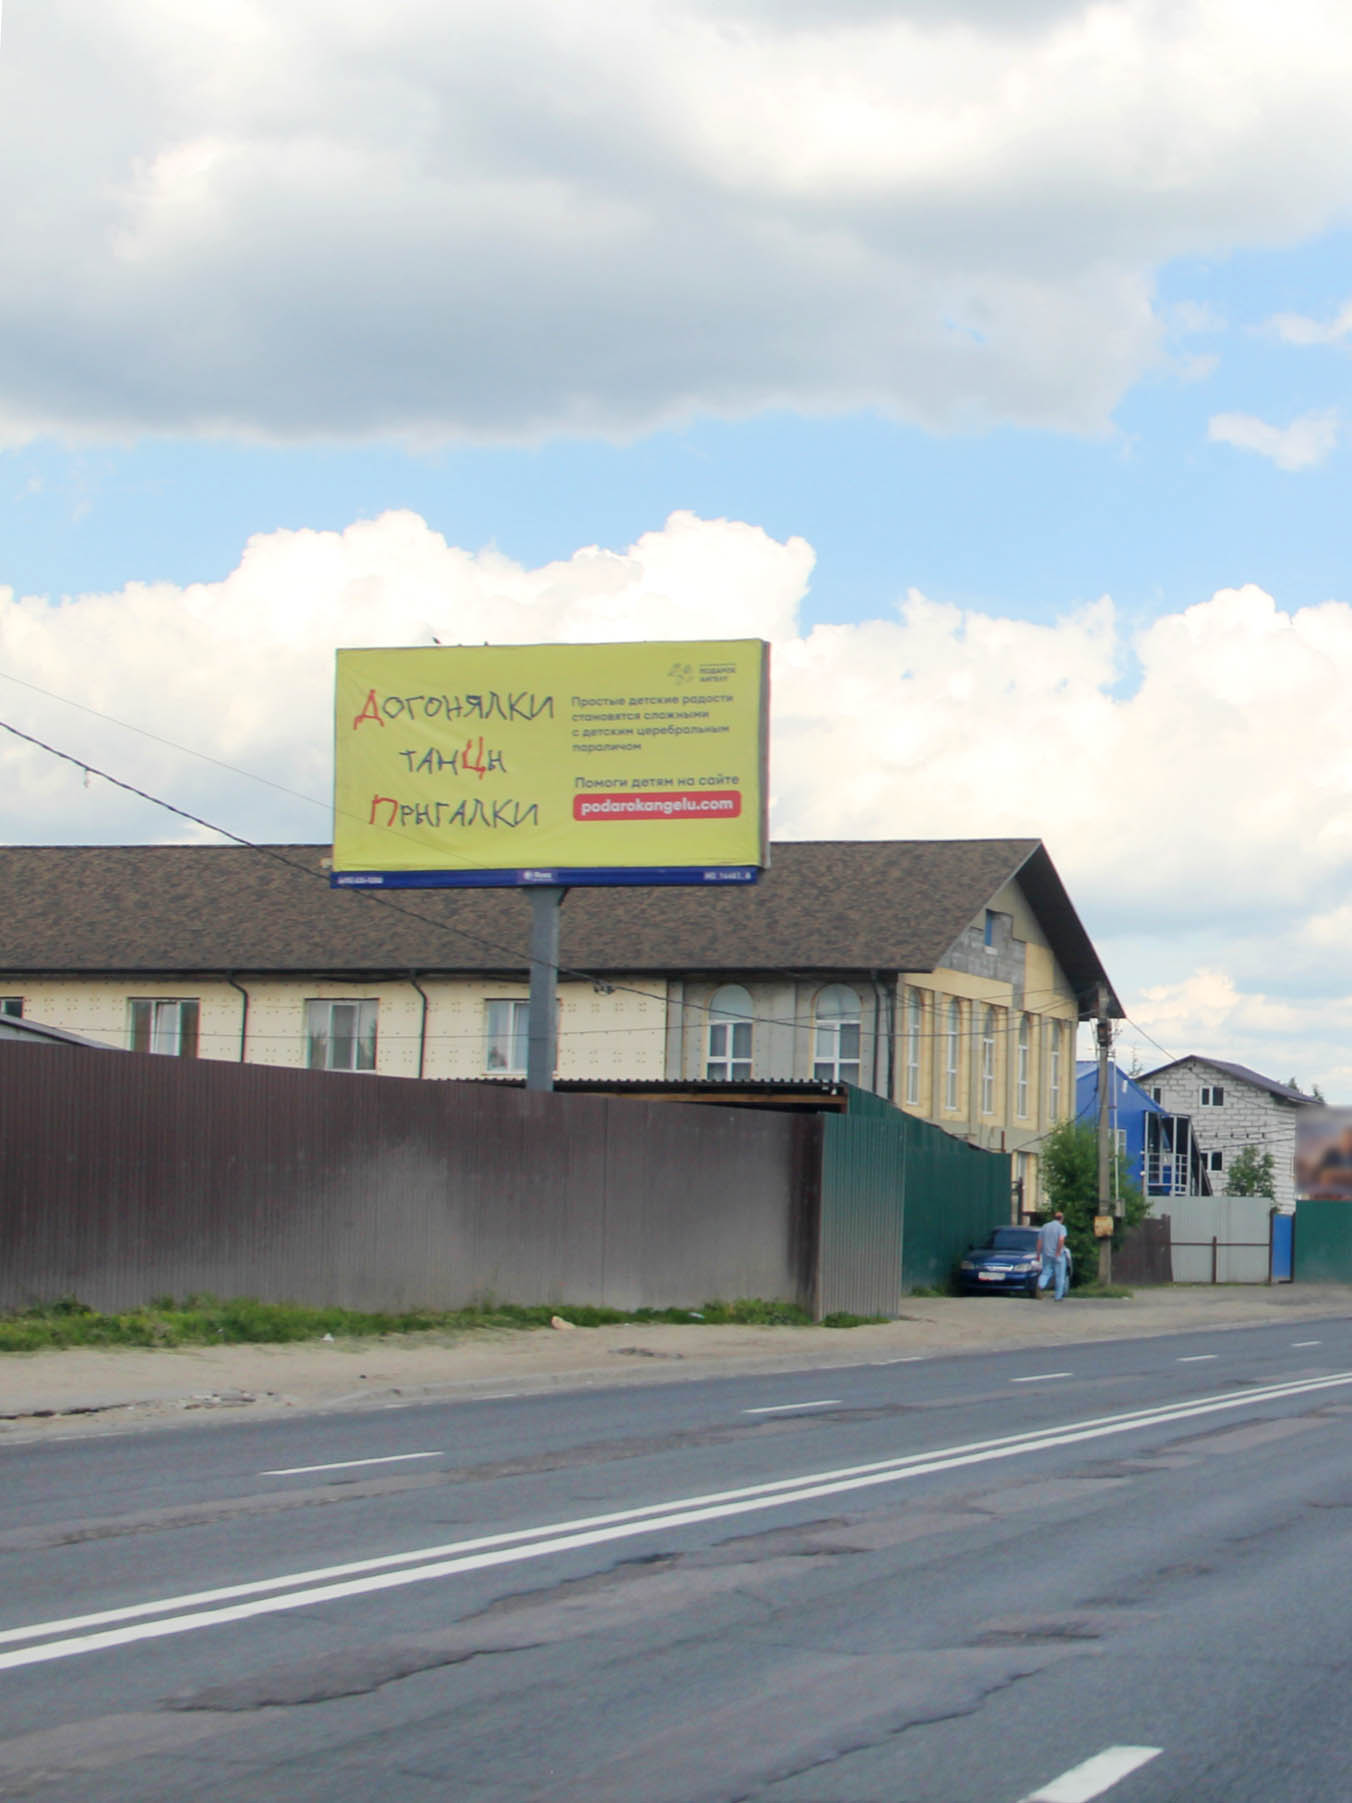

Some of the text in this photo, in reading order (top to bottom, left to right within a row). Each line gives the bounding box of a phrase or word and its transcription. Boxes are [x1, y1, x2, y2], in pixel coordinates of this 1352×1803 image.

[571, 694, 733, 706] Простые детские радости
[571, 711, 709, 721] становятся сложными
[582, 729, 634, 737] детским
[636, 724, 730, 736] церебральным
[571, 743, 642, 753] параличом
[575, 774, 740, 788] Помоги детям на сайте
[581, 797, 734, 816] podarokangelu.com
